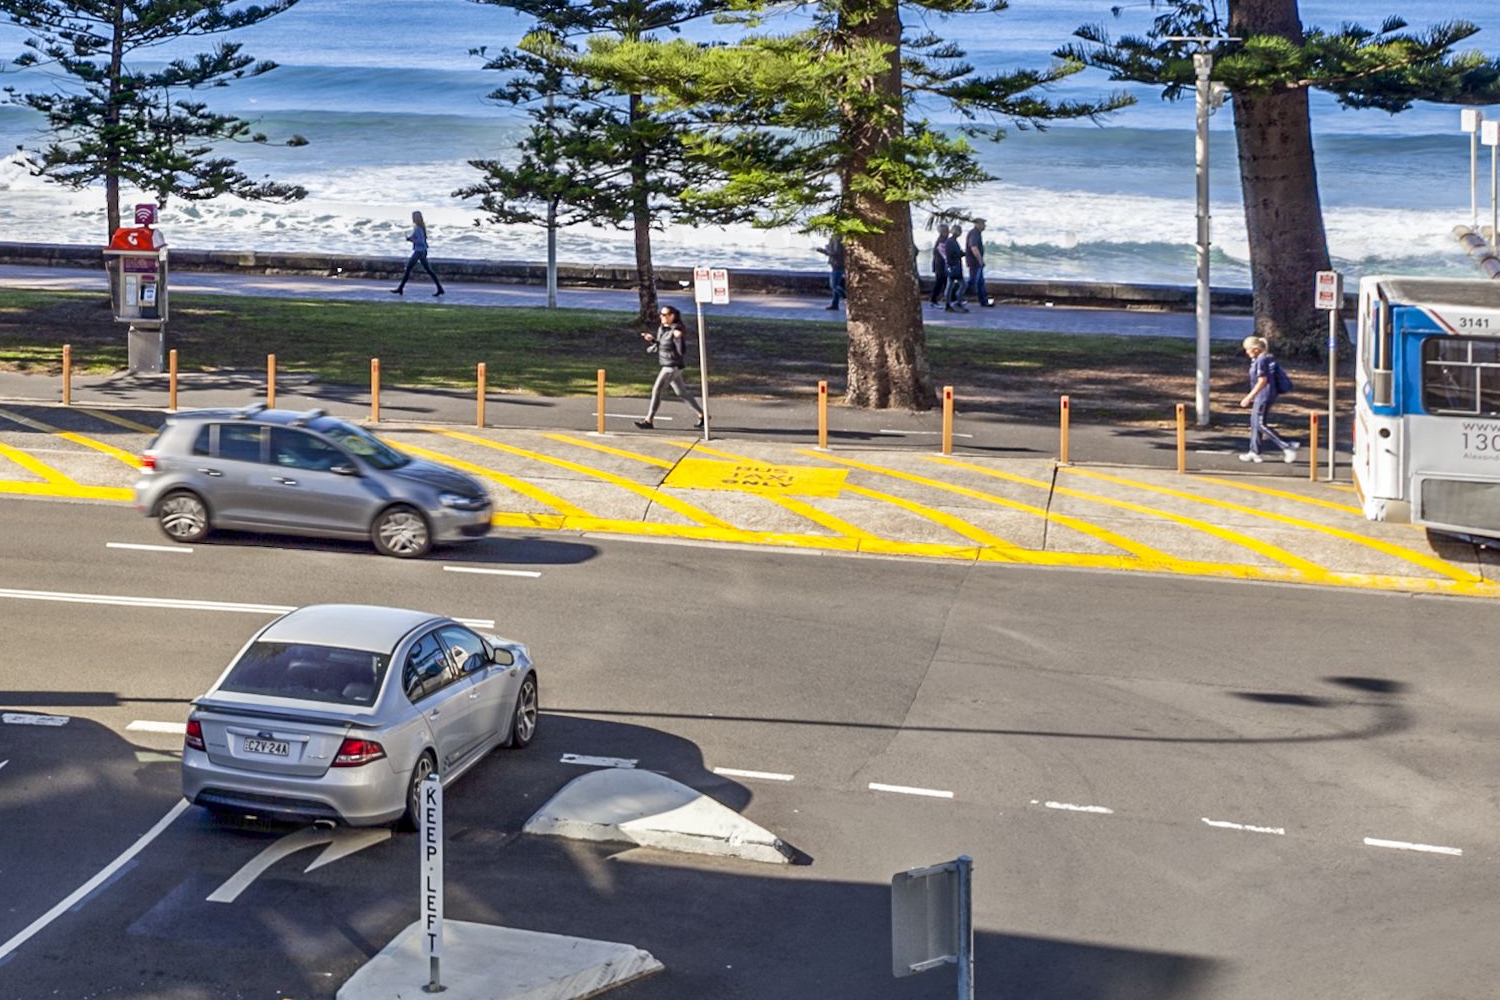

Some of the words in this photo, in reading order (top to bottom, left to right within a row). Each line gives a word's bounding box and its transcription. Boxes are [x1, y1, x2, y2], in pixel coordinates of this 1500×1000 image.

[1460, 317, 1489, 328] 3141
[733, 472, 795, 482] TAXI
[721, 479, 793, 488] ONLY
[426, 788, 437, 862] KEEP
[427, 876, 437, 953] LEFT
